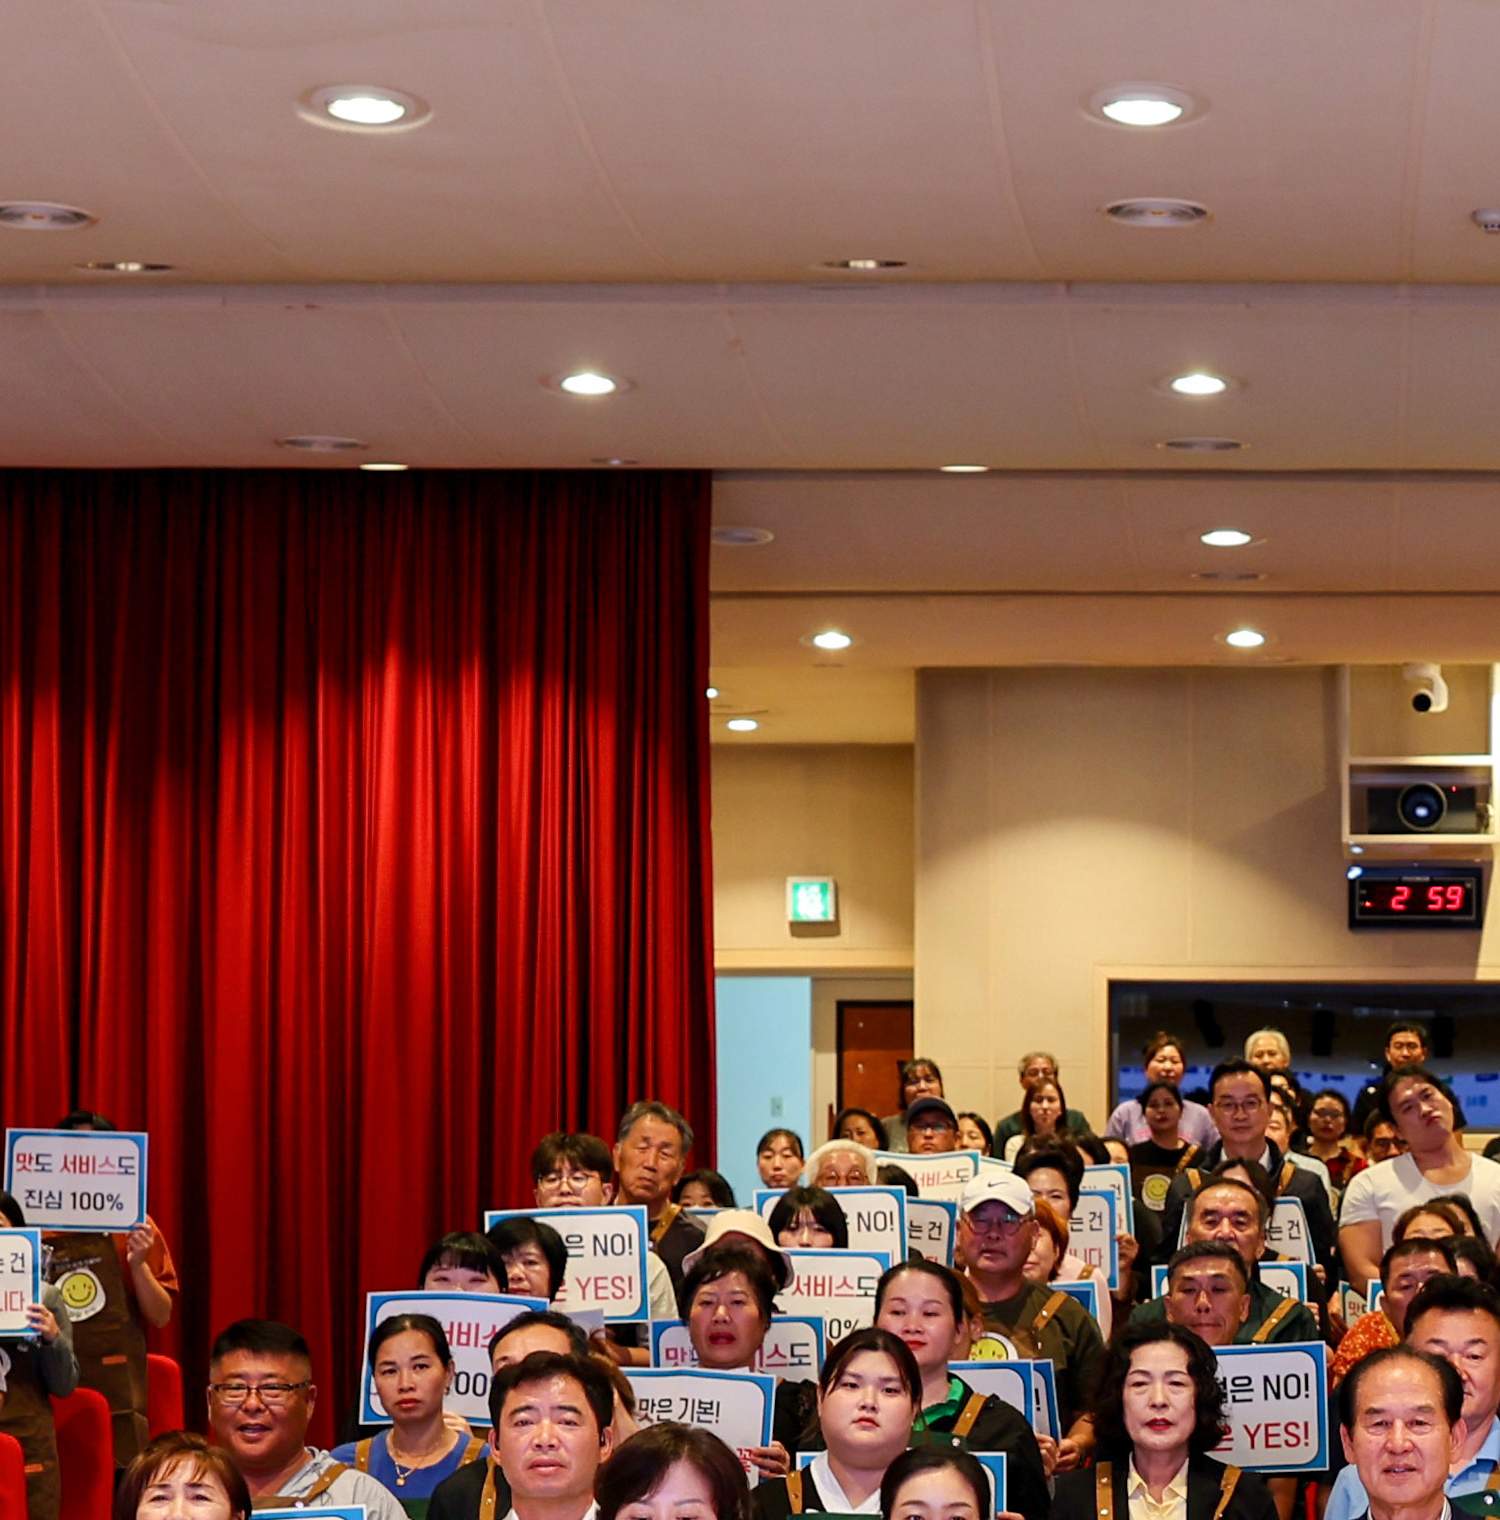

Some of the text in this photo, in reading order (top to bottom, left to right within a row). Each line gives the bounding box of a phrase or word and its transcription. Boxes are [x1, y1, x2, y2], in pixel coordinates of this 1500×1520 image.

[16, 1153, 135, 1175] 맛도 서비스도
[25, 1190, 123, 1211] 진심 100%
[857, 1211, 893, 1232] NO!
[928, 1222, 942, 1241] 건
[1089, 1212, 1103, 1231] 건
[1288, 1220, 1301, 1240] 건
[593, 1234, 632, 1256] NO!
[11, 1253, 25, 1273] 건
[575, 1276, 633, 1300] YES!
[792, 1275, 875, 1297] 서비스도
[1263, 1373, 1309, 1400] NO!
[678, 1398, 720, 1424] 기본!
[1243, 1421, 1309, 1449] YES!
